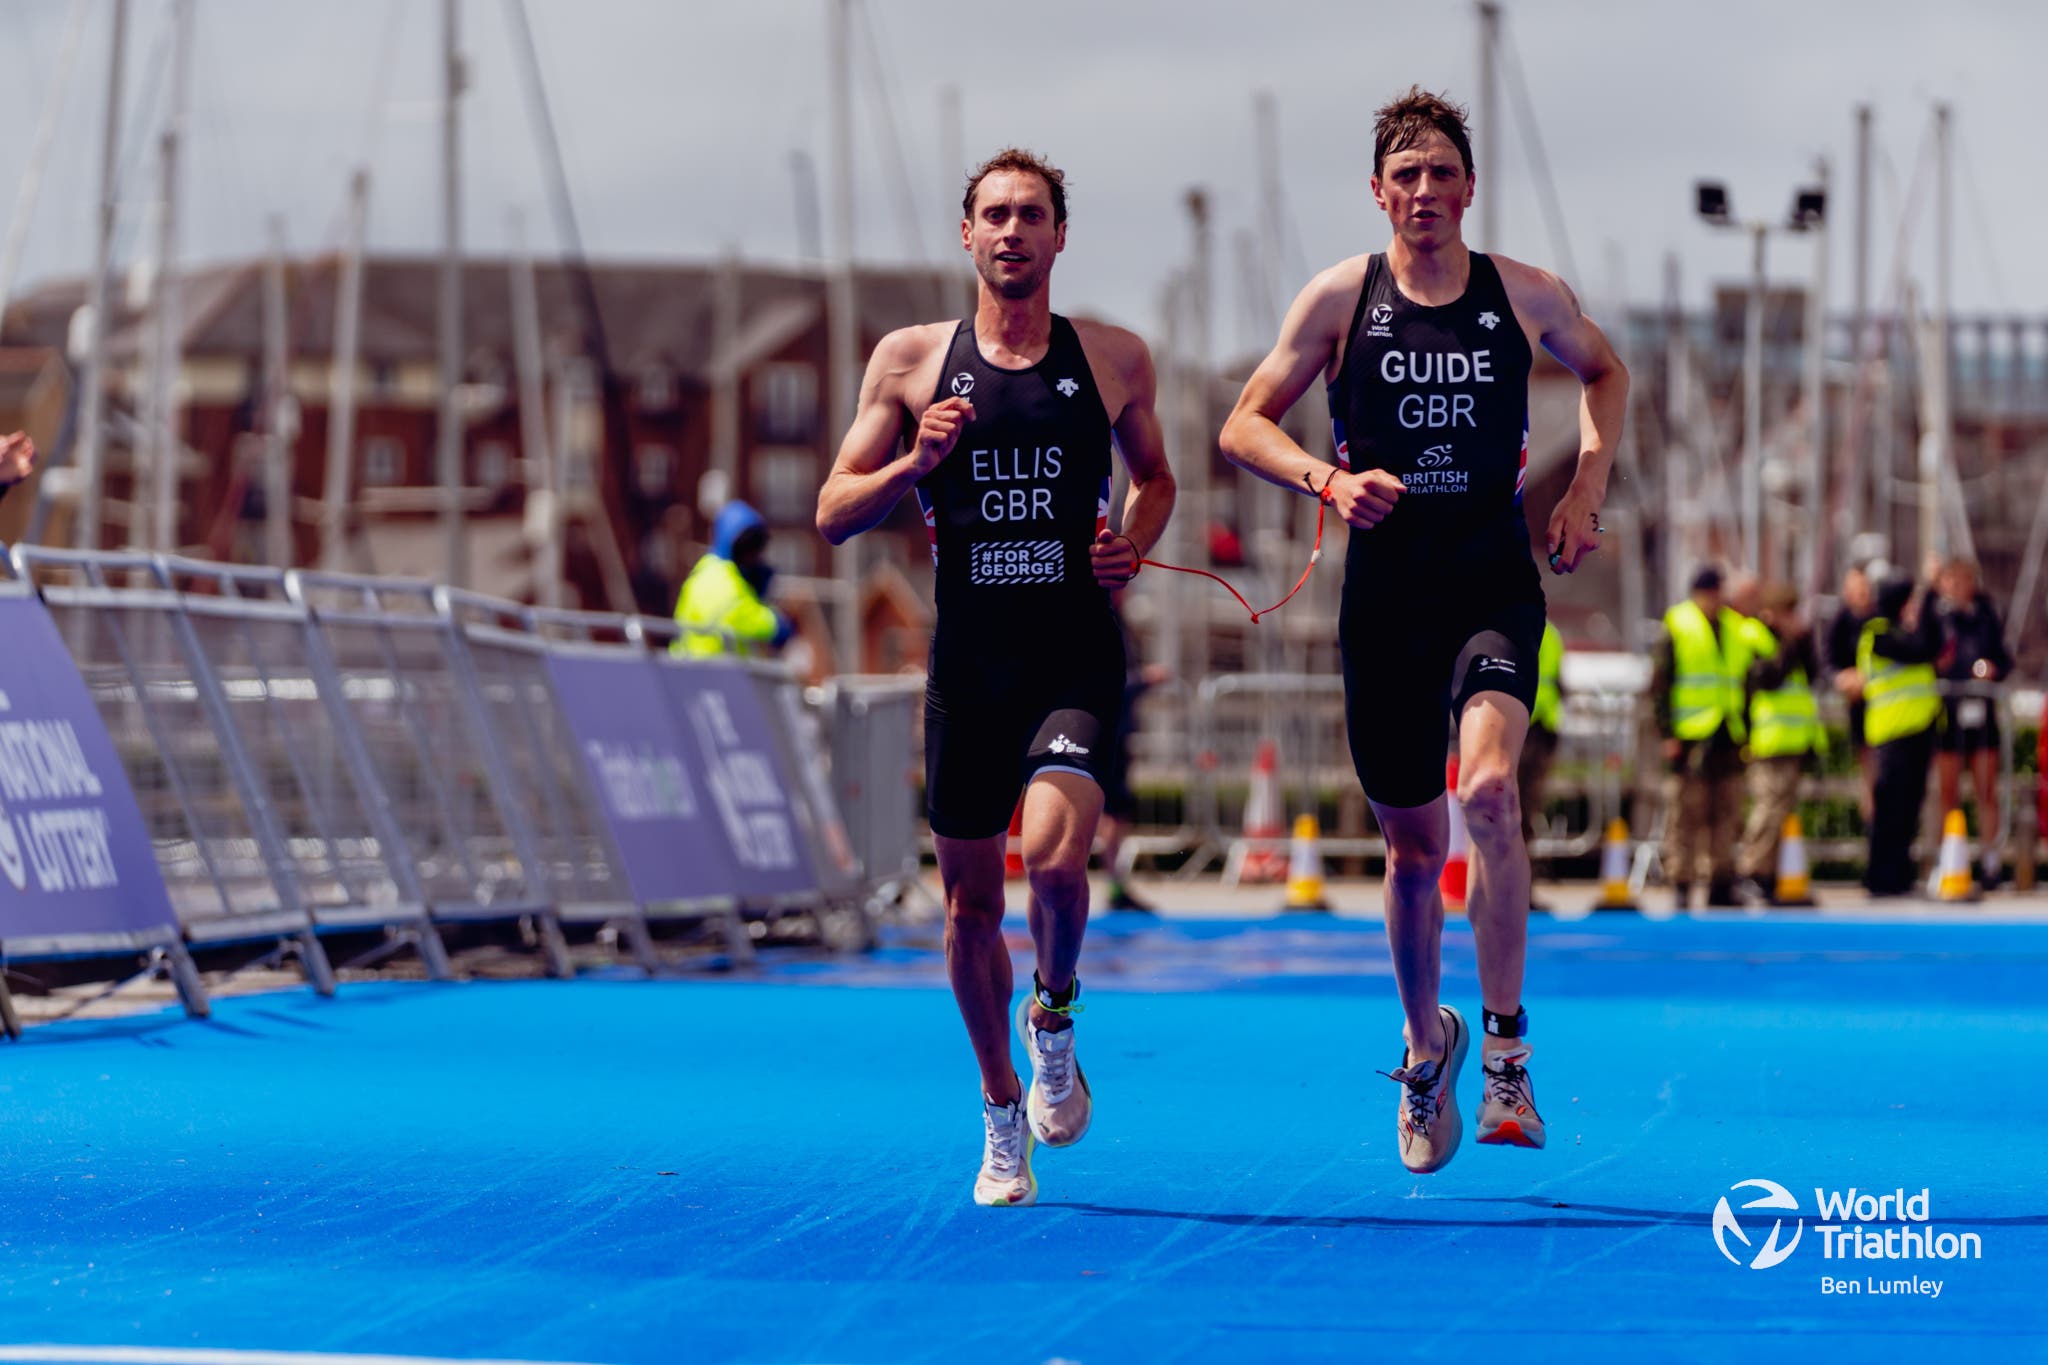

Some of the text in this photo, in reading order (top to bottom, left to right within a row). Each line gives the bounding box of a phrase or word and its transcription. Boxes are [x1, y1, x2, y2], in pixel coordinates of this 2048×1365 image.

[1381, 350, 1494, 383] GUIDE
[1398, 394, 1477, 428] GBR
[972, 447, 1063, 481] ELLIS
[1402, 471, 1468, 485] BRITISH
[981, 488, 1054, 522] GBR
[981, 562, 1054, 576] GEORGE
[982, 550, 1030, 563] #FOR
[16, 808, 119, 891] LOTTERY
